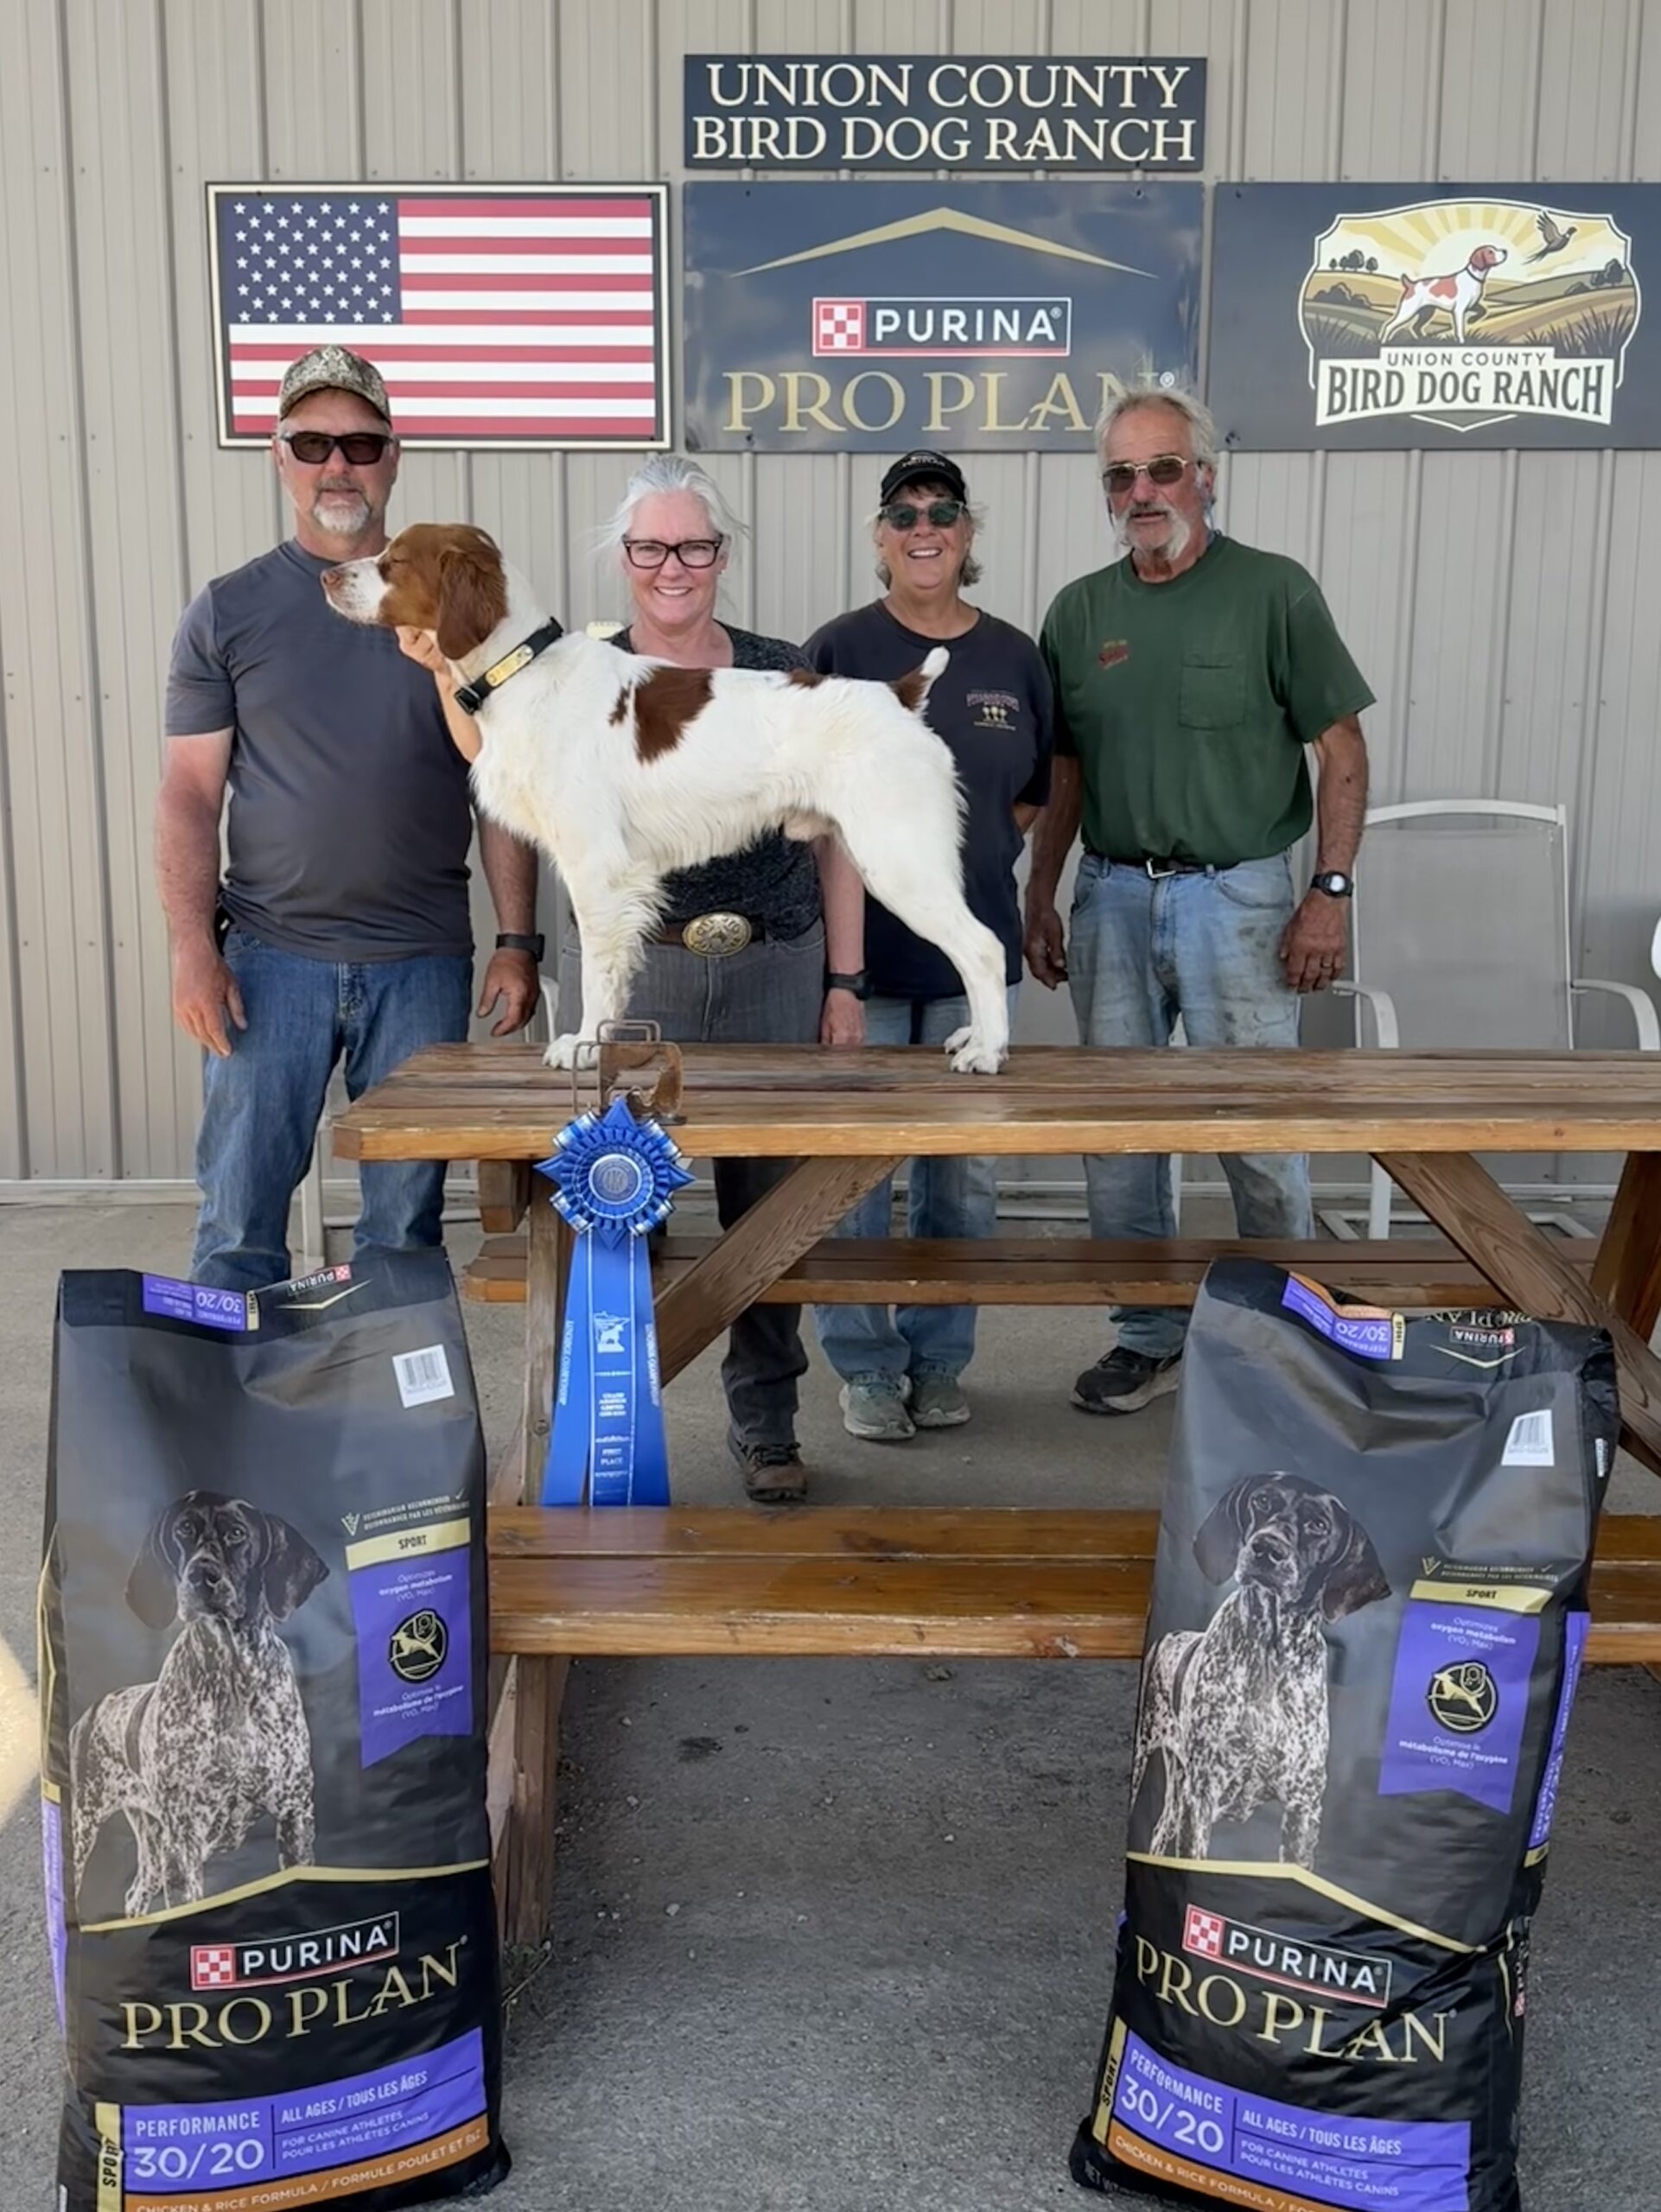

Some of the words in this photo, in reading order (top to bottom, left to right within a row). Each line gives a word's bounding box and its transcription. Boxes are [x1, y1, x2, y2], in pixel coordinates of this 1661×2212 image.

[706, 63, 914, 107] UNION
[927, 64, 1191, 109] COUNTY
[692, 117, 827, 160] BIRD
[841, 117, 972, 162] DOG
[983, 118, 1197, 162] RANCH
[1386, 352, 1453, 367] UNION
[1461, 351, 1547, 367] COUNTY
[722, 371, 907, 433] PRO
[1326, 365, 1405, 417] BIRD
[1416, 370, 1481, 405] DOG
[1492, 364, 1605, 416] RANCH
[195, 1292, 242, 1313] 30/20
[290, 1271, 334, 1293] PURINA
[1336, 1322, 1389, 1342] 30/20
[398, 1535, 427, 1550] SPORT
[1466, 1589, 1498, 1599] SPORT
[1430, 1622, 1464, 1636] oxygen
[1466, 1628, 1517, 1644] metabolism
[243, 1924, 388, 1976] PURINA
[1228, 1929, 1378, 1994] PURINA
[119, 1997, 272, 2050] PRO
[284, 1942, 461, 2038] PLAN
[1135, 1935, 1247, 2028] PRO
[1256, 1991, 1448, 2063] PLAN
[281, 2108, 302, 2124] ALL
[305, 2099, 336, 2119] AGES
[347, 2088, 375, 2108] TOUS
[378, 2081, 398, 2099] LES
[1101, 2056, 1118, 2107] SPORT
[1130, 2048, 1224, 2115] PERFORMANCE
[135, 2111, 261, 2138] PERFORMANCE
[282, 2136, 305, 2149] FOR
[308, 2126, 348, 2143] CANINE
[351, 2110, 404, 2132] ATHLETES
[282, 2145, 314, 2159] POUR
[315, 2140, 335, 2153] LES
[392, 2112, 430, 2133] CANINS
[1121, 2074, 1225, 2153] 30/20
[1242, 2109, 1263, 2129] ALL
[1265, 2120, 1298, 2139] AGES
[1308, 2127, 1342, 2149] TOUS
[1343, 2136, 1367, 2153] LES
[1369, 2134, 1403, 2156] ÂGES
[102, 2138, 121, 2188] SPORT
[133, 2139, 265, 2180] 30/20
[215, 2196, 248, 2212] RICE
[251, 2184, 318, 2205] FORMULA
[332, 2164, 395, 2188] FORMULE
[398, 2146, 445, 2171] POULET
[449, 2139, 462, 2154] ET
[1115, 2135, 1163, 2170] CHICKEN
[1164, 2163, 1175, 2174] &
[1177, 2166, 1207, 2184] RICE
[1210, 2177, 1276, 2208] FORMULA
[1240, 2152, 1271, 2169] POUR
[1273, 2160, 1295, 2176] LES
[1355, 2182, 1399, 2197] CANINS
[1241, 2139, 1264, 2155] FOR
[1266, 2148, 1308, 2167] CANINE
[1311, 2160, 1368, 2181] ATHLETES
